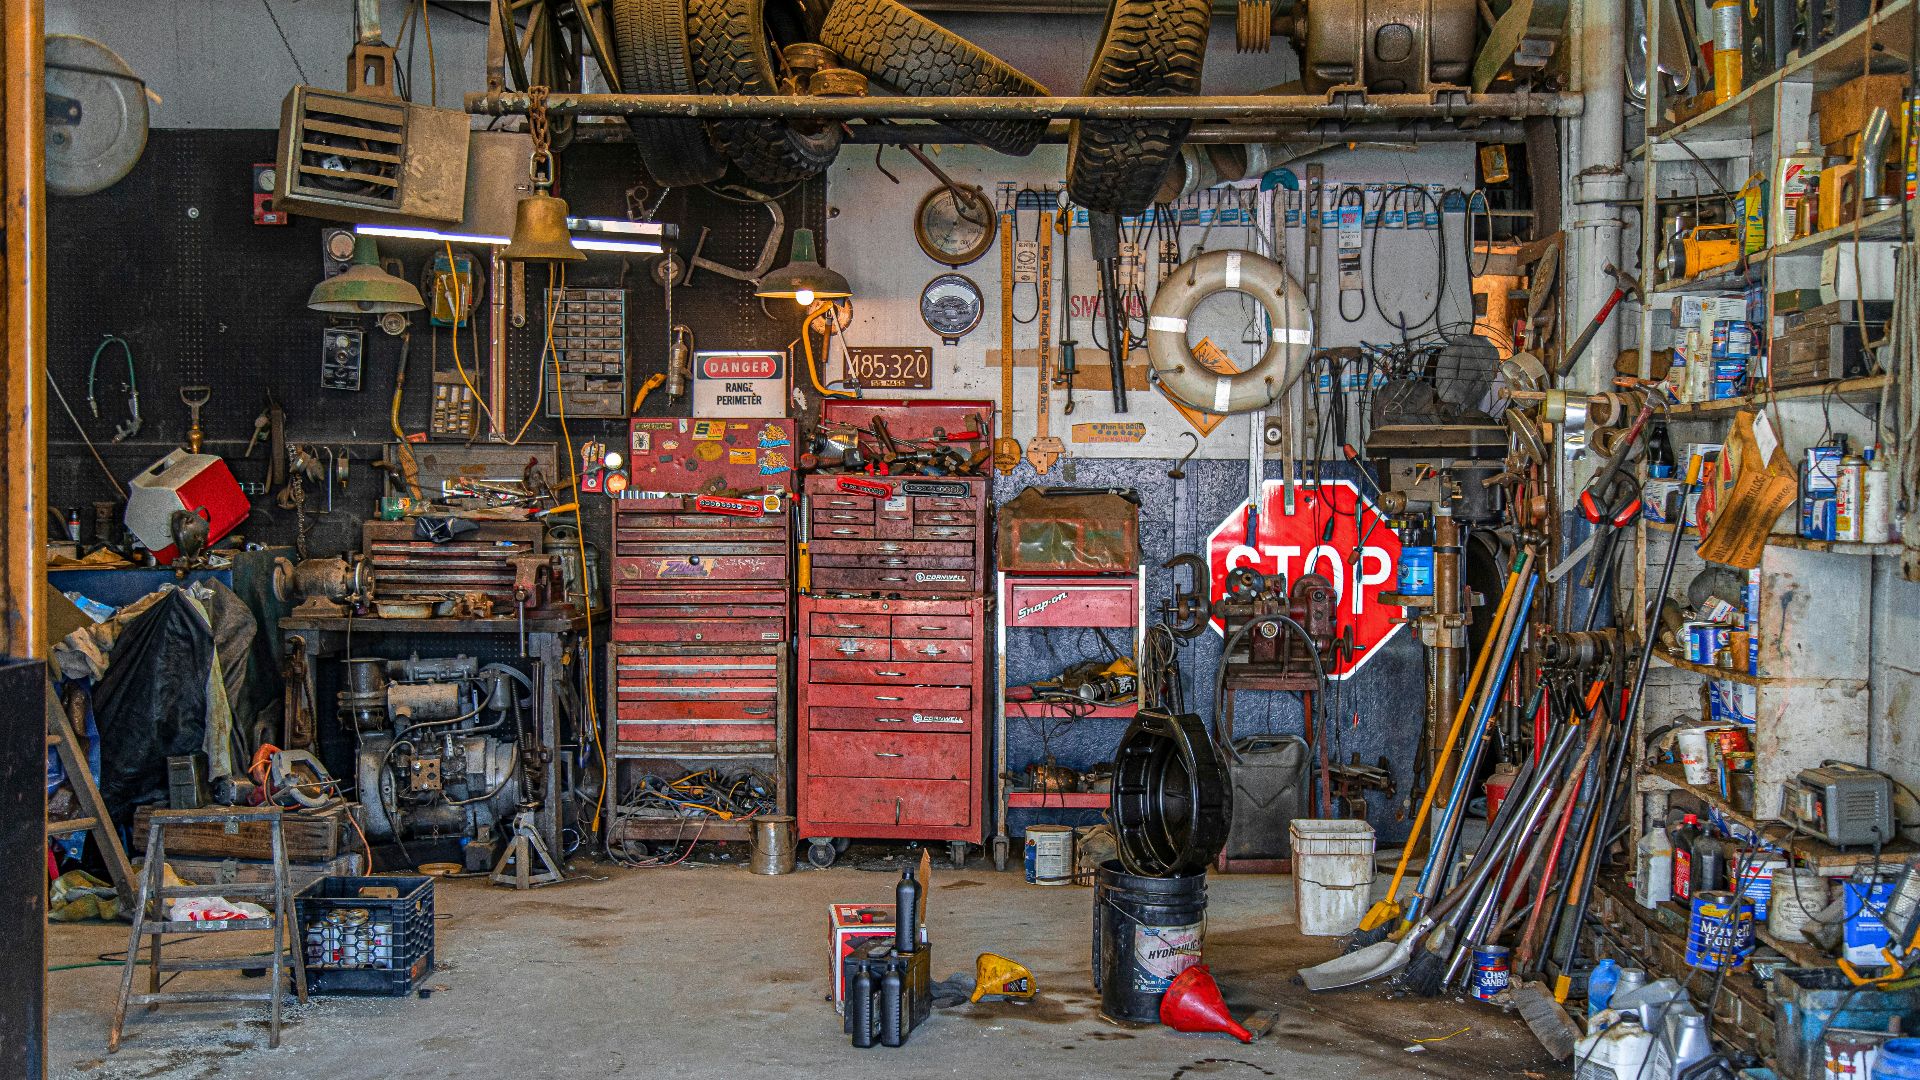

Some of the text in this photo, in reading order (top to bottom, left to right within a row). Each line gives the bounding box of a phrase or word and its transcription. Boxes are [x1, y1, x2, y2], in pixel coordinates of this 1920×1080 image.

[1070, 295, 1148, 318] SMING
[709, 361, 769, 373] DANGER
[725, 382, 754, 393] RANGE
[716, 394, 762, 406] PERIMETER
[1017, 592, 1068, 620] Snap-on
[1484, 970, 1508, 979] CHAS
